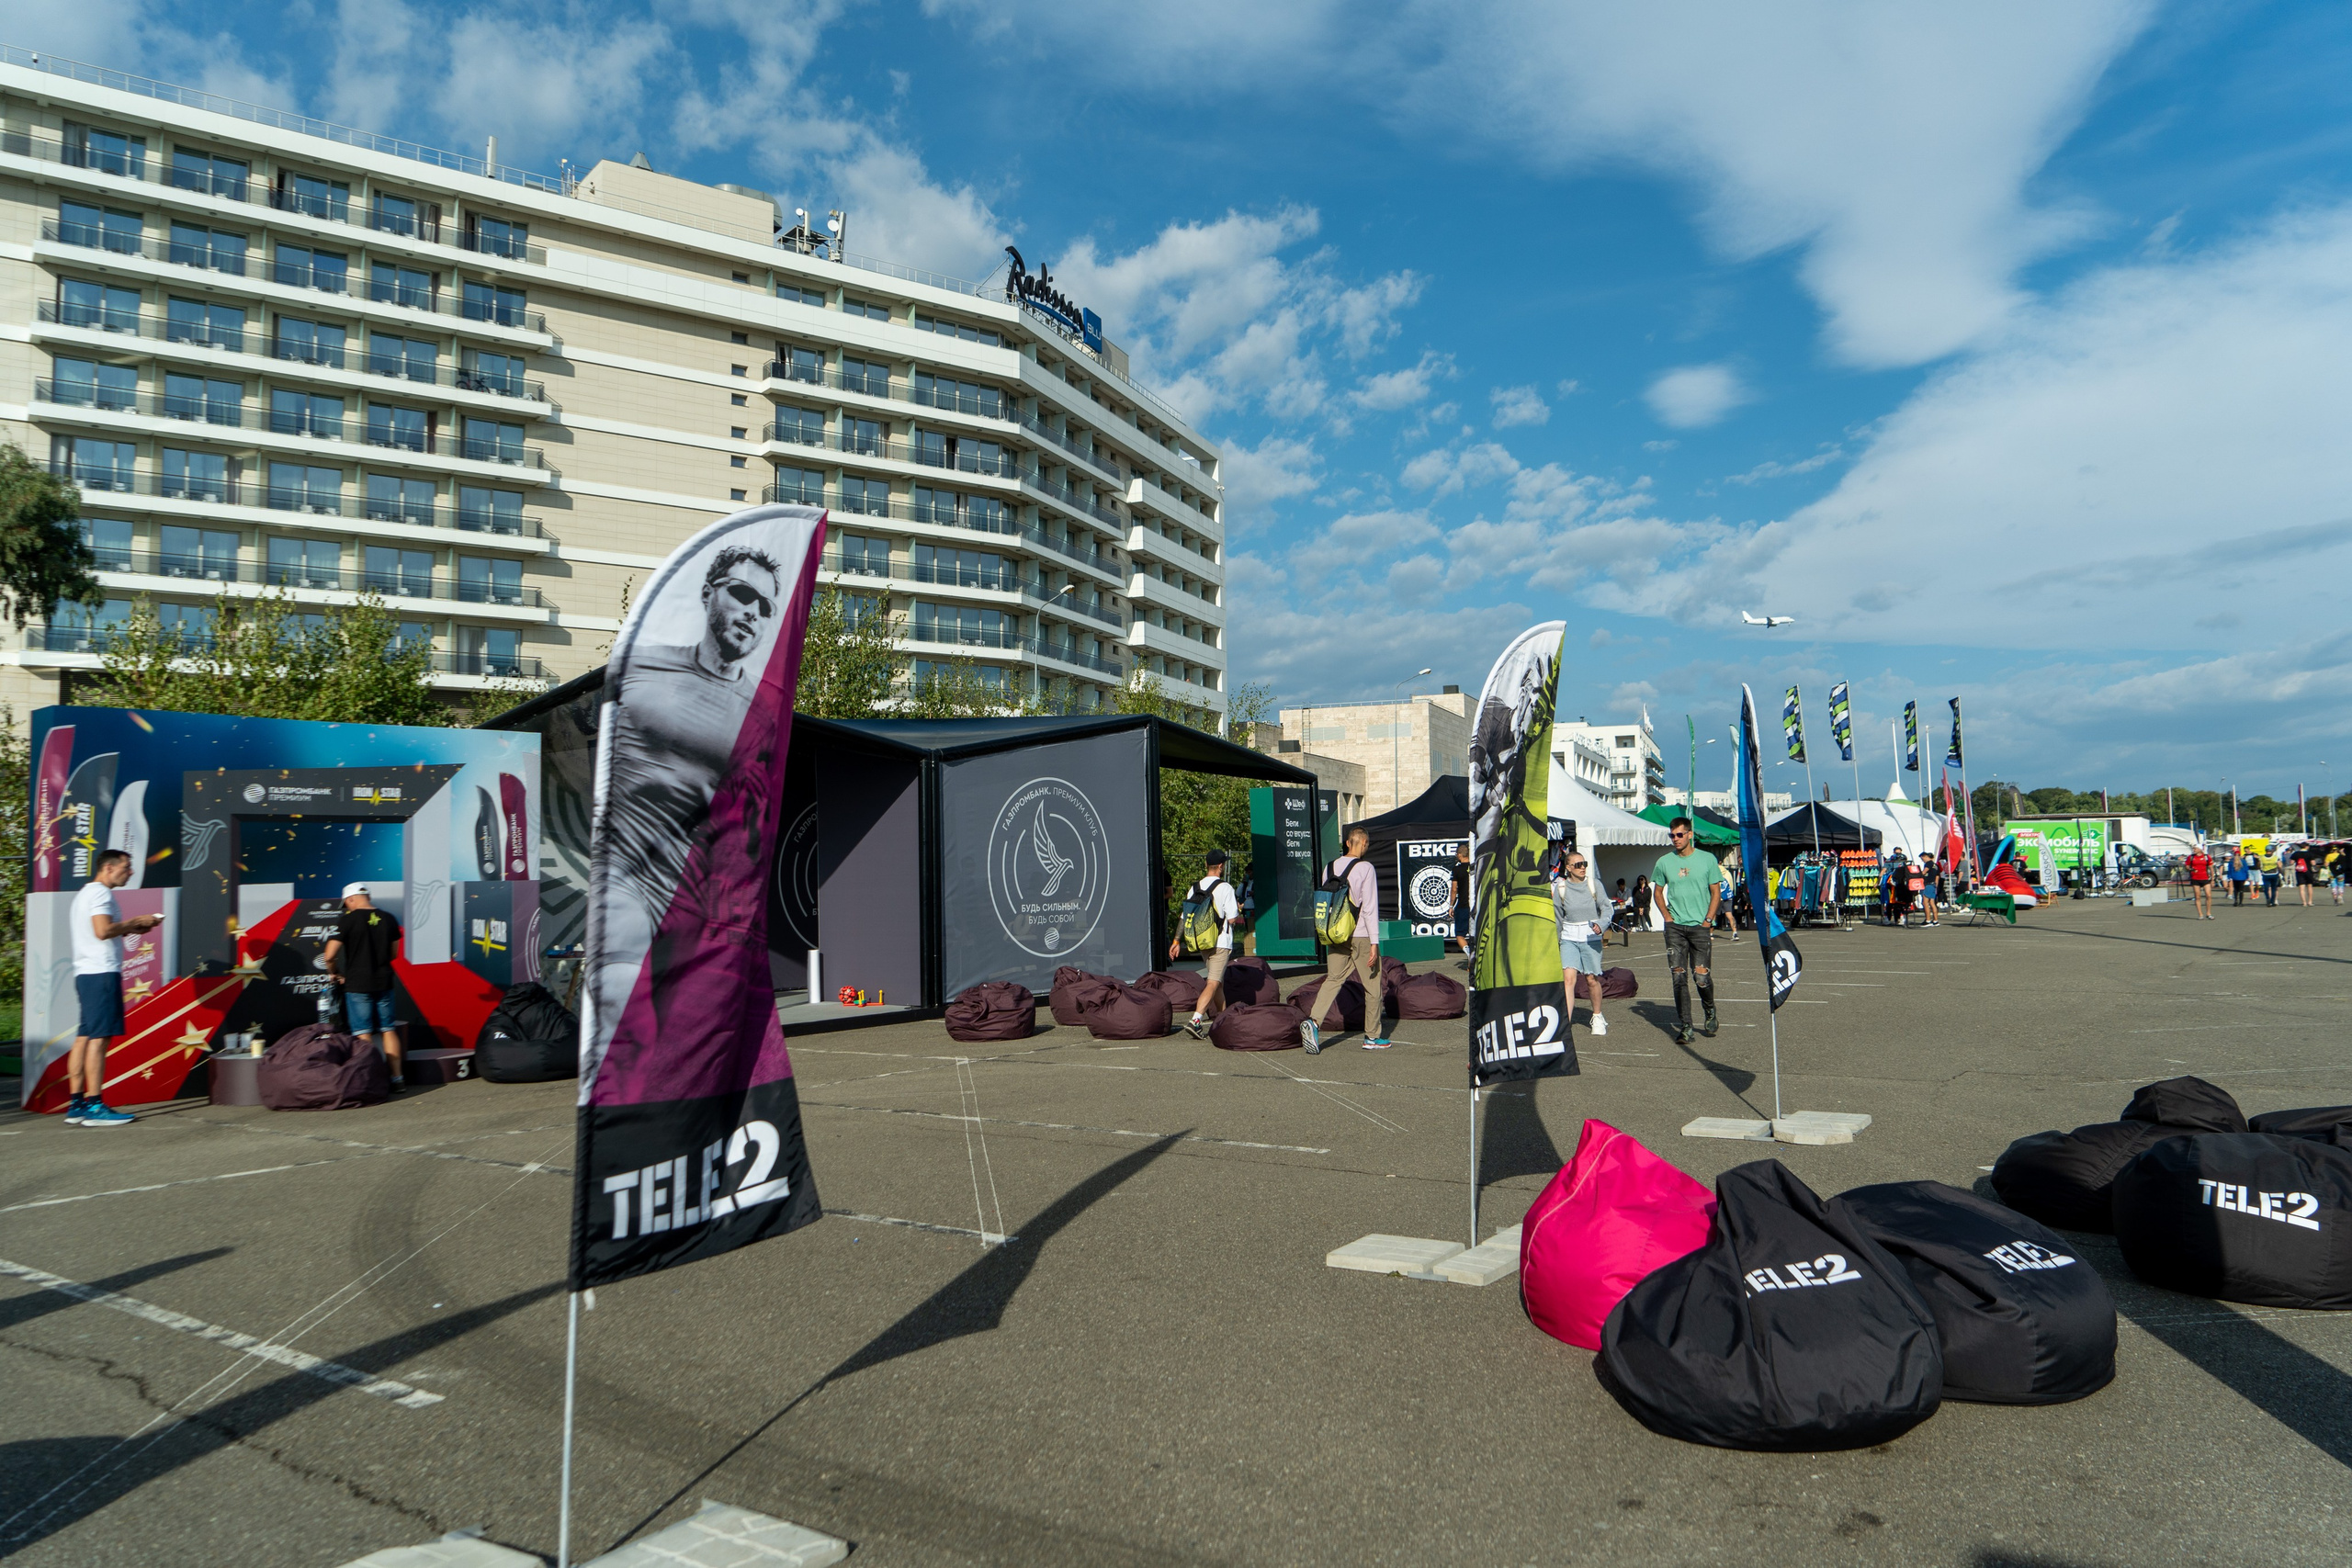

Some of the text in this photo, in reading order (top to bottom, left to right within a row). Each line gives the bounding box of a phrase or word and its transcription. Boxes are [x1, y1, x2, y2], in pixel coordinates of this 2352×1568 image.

[1005, 245, 1085, 332] Radisson
[1087, 321, 1102, 341] BLU
[268, 786, 332, 795] ГАЗПРОМБАНК
[353, 786, 401, 798] IRON STAR
[1002, 786, 1098, 837] ГАЗПРОМБАНК. ПРЕМИУМ КЛУБ
[793, 812, 818, 843] ГАЗПРО
[73, 802, 91, 877] IRON STAR
[1408, 843, 1458, 858] BIKE
[2053, 847, 2099, 855] SYNEREIC
[1021, 903, 1081, 913] БУДЬ СИЛЬНЫМ.
[1314, 901, 1328, 919] 113
[1028, 912, 1075, 925] БУДЬ СОБОЙ
[472, 919, 485, 937] IRON
[490, 920, 507, 942] STAR
[280, 974, 333, 985] ГАЗПРО
[1476, 1004, 1566, 1065] TELE2
[456, 1058, 469, 1078] 3
[603, 1119, 790, 1240] TELE2
[2198, 1178, 2321, 1232] TELE2
[1744, 1254, 1862, 1299] ELE2
